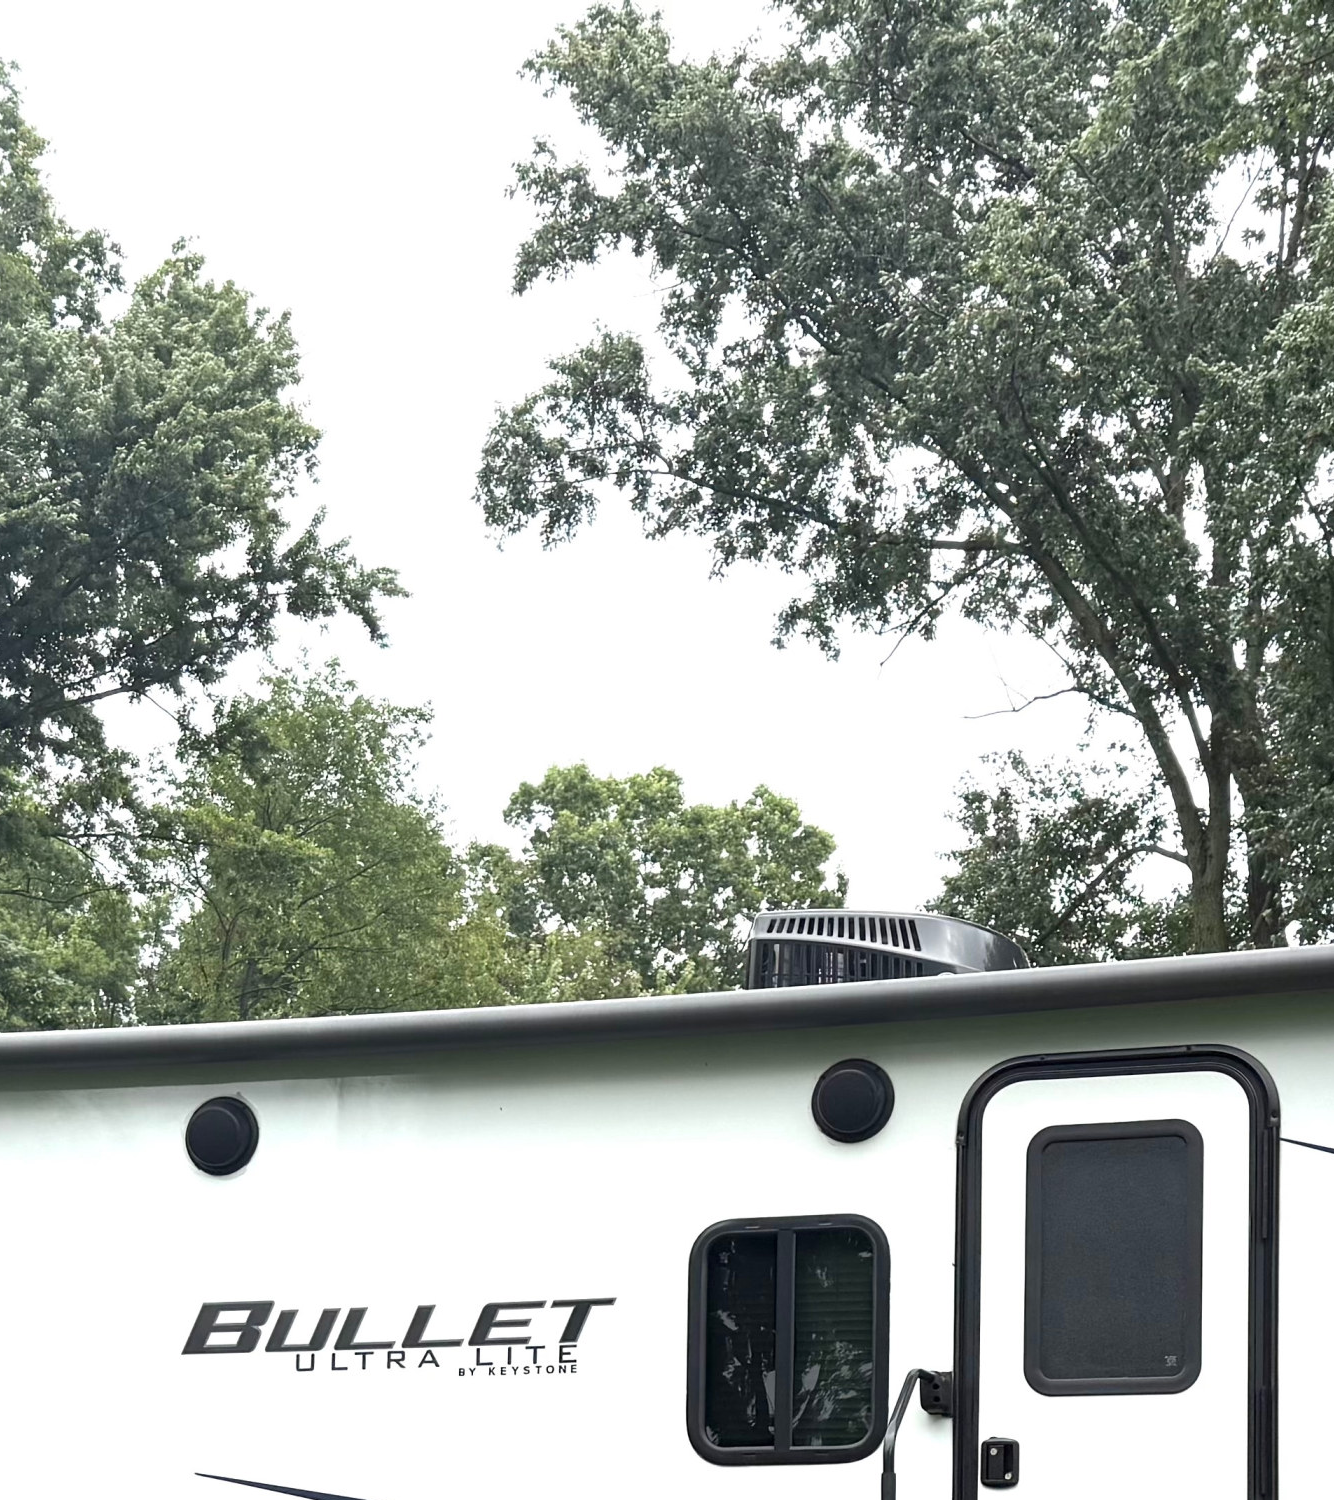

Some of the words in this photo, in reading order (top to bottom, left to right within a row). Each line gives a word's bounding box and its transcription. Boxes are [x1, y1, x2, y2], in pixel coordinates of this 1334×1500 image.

[181, 1297, 617, 1356] BULLET
[296, 1348, 440, 1372] ULTRA
[475, 1344, 578, 1366] LITE
[458, 1367, 477, 1377] BY
[488, 1364, 578, 1376] KEYSTONE
